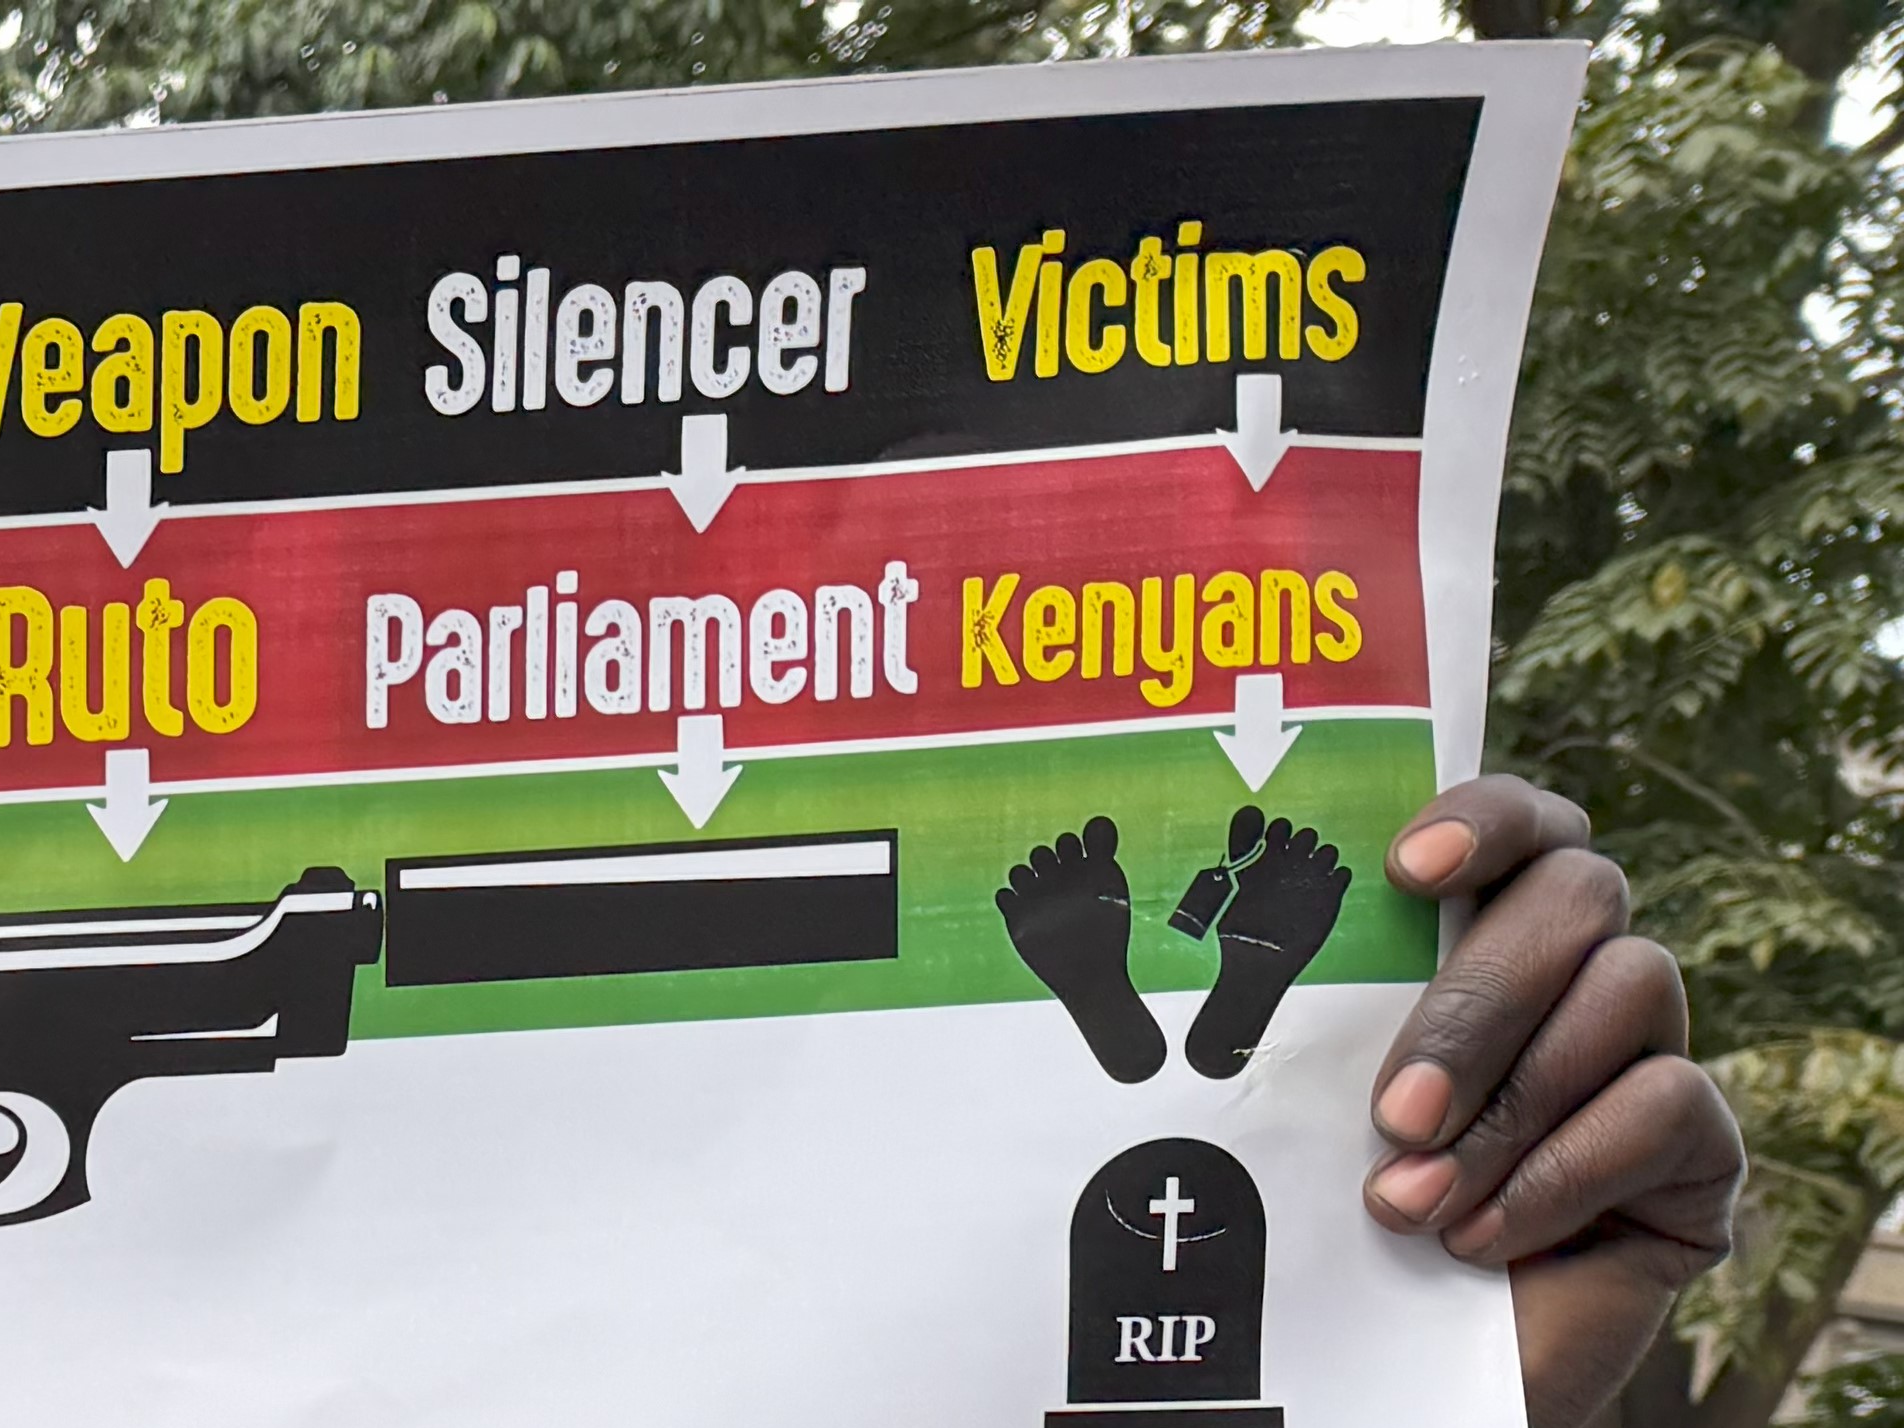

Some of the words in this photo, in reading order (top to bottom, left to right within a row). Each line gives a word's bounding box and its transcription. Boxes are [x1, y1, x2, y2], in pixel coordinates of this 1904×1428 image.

[424, 254, 867, 417] Silencer
[971, 220, 1366, 382] Victims
[366, 559, 919, 730] Parliament
[961, 568, 1363, 708] Kenyans
[1114, 1315, 1216, 1362] RIP
